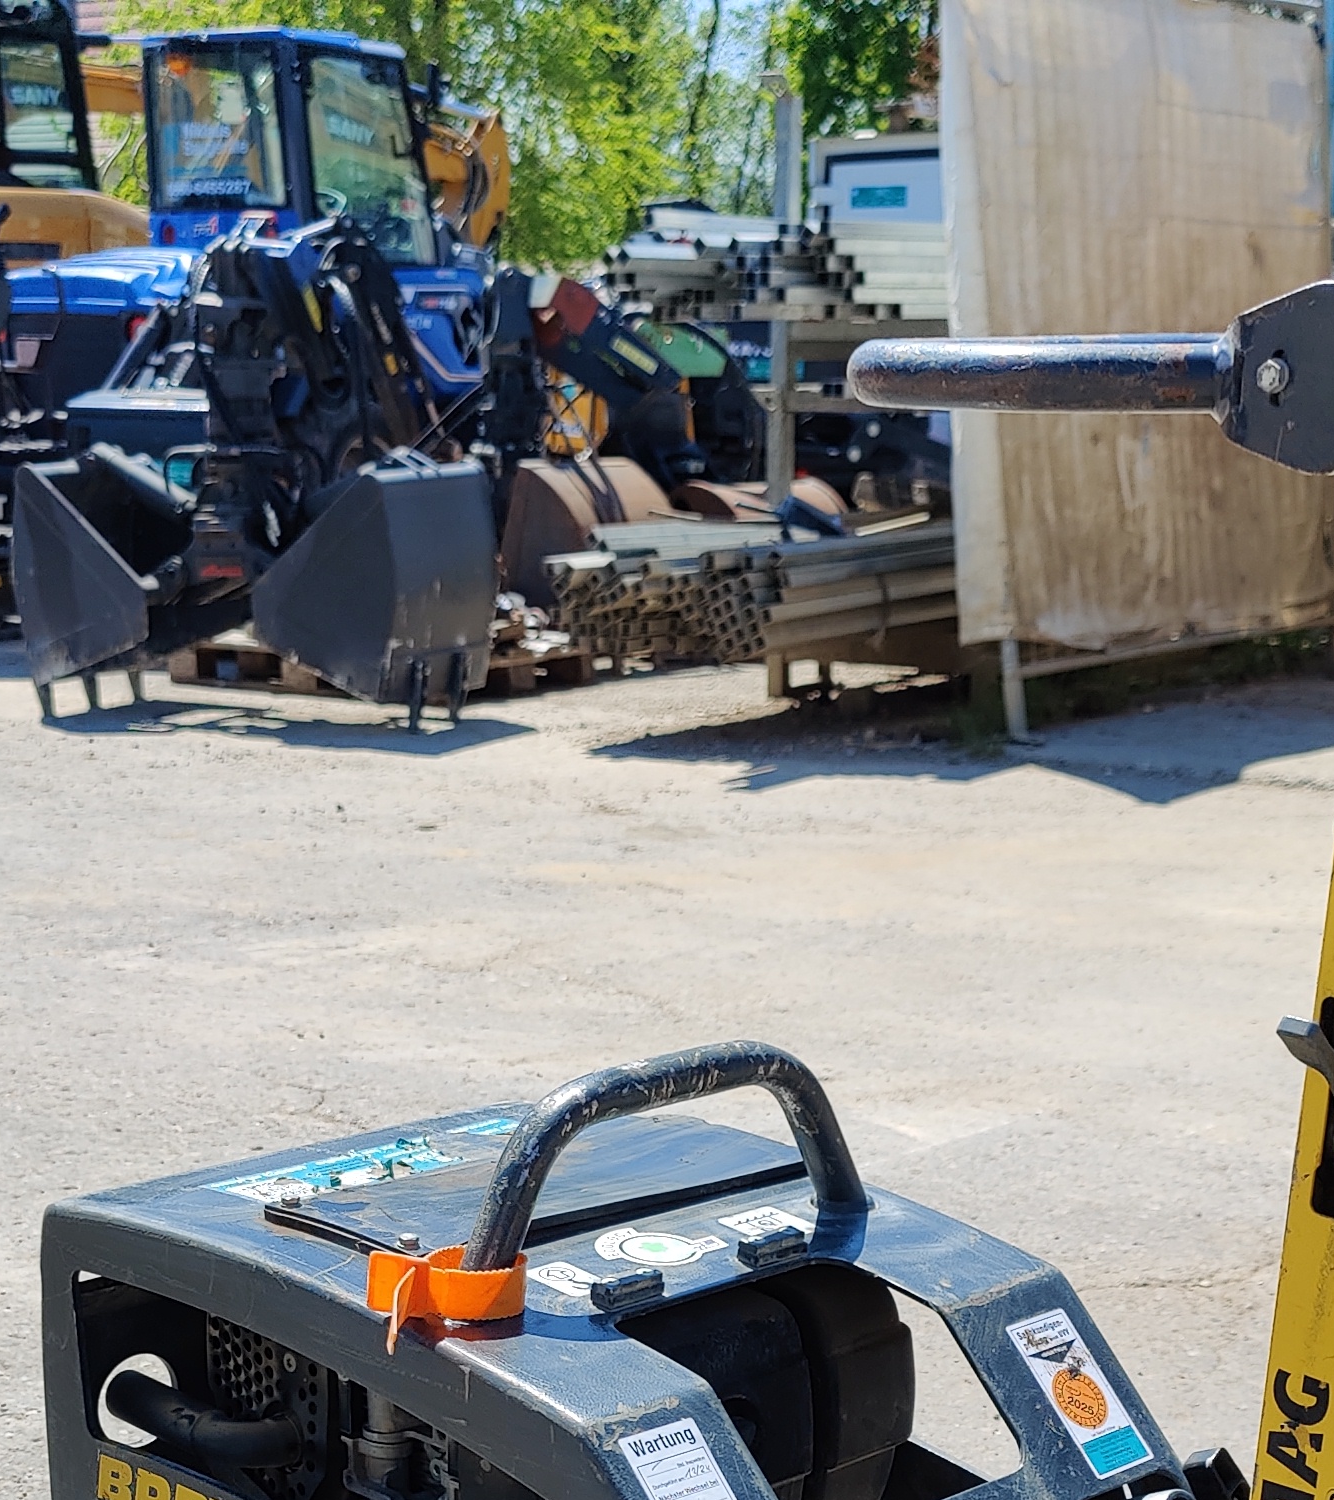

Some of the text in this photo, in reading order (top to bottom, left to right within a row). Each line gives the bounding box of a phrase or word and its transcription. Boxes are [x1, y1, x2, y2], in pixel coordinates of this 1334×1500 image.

[1067, 1396, 1095, 1416] 2025
[628, 1428, 697, 1458] Wartung
[685, 1481, 709, 1495] Wechsel
